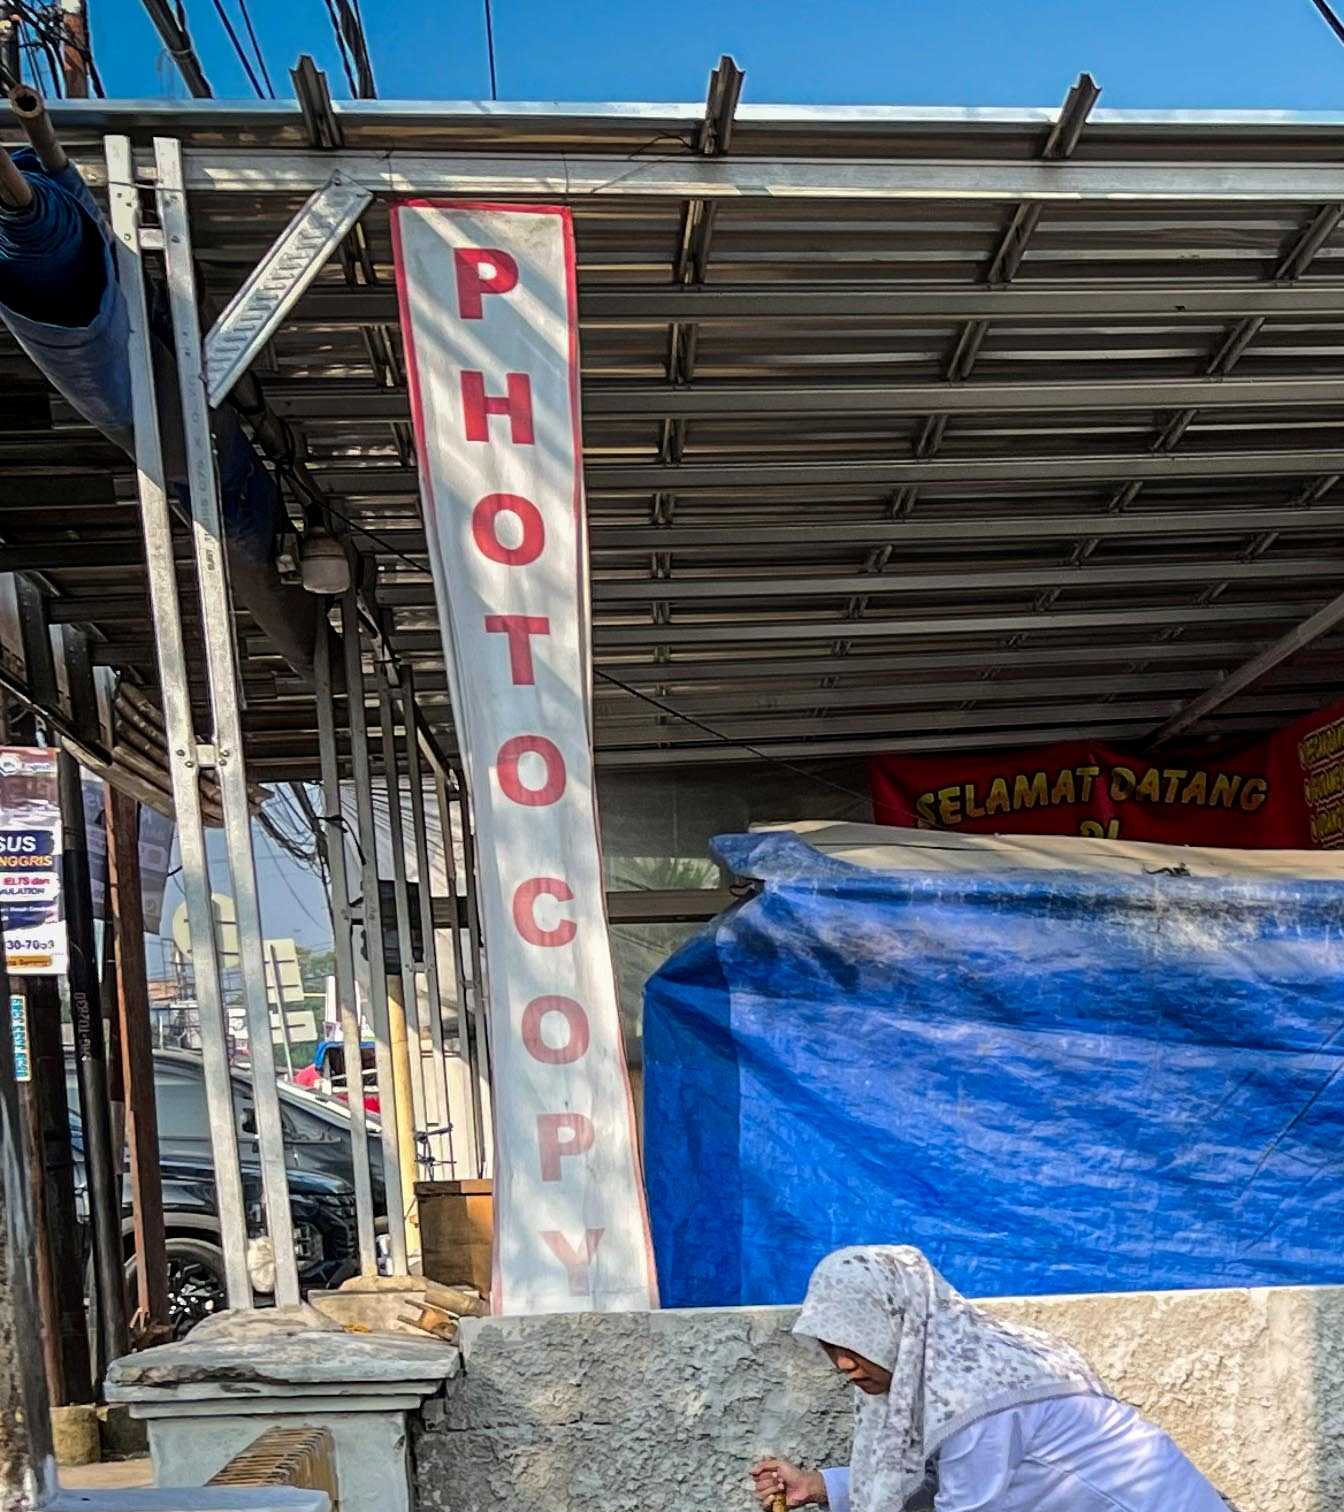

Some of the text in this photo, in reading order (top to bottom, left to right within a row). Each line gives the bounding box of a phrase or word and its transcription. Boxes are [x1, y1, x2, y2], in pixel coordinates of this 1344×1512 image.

[454, 247, 605, 1297] PHOTOCOPY
[915, 766, 1100, 827] SELAMAT
[1109, 766, 1270, 812] DATANG
